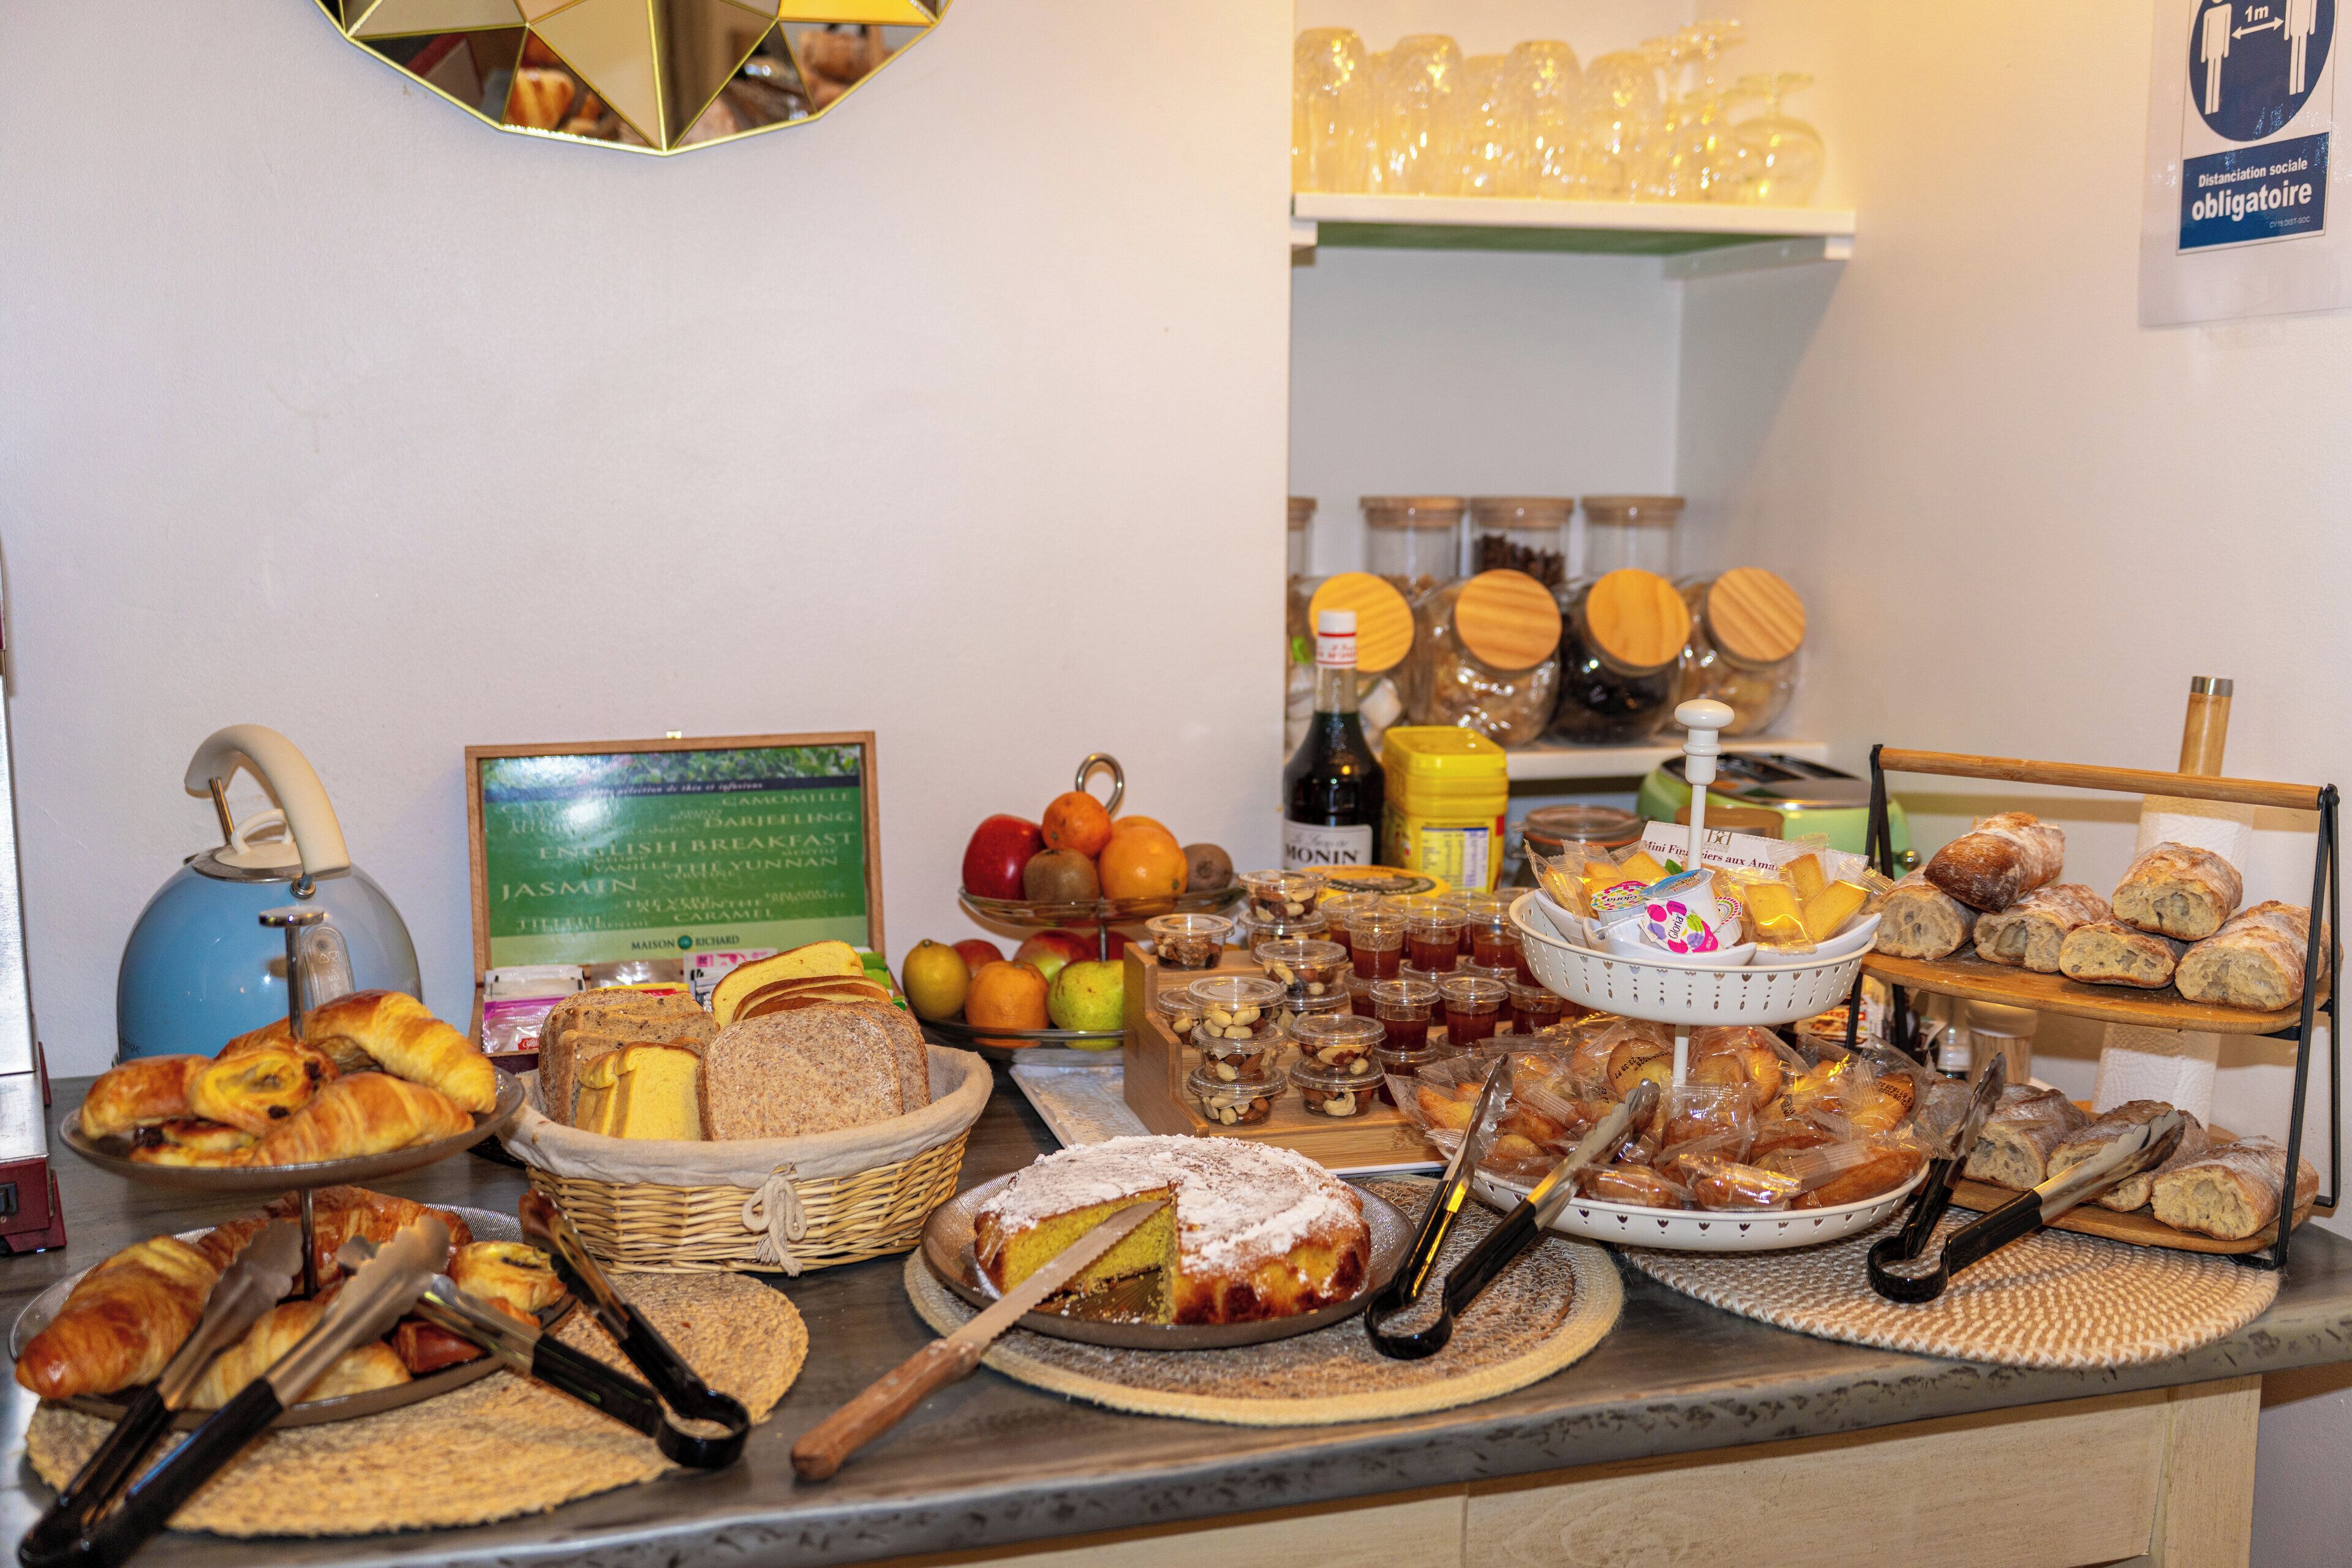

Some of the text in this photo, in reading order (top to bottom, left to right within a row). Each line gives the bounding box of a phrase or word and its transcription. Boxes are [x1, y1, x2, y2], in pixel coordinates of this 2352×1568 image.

[2245, 5, 2269, 23] 1m
[2198, 157, 2308, 188] Distanciation sociale
[2192, 179, 2312, 222] obligatoire
[721, 792, 851, 807] CAMOMILLE
[704, 811, 854, 828] DARJEELING
[539, 832, 855, 860] ENGLISH BREAKFAST
[730, 856, 839, 870] YUNNAN
[1725, 856, 1746, 865] aux
[501, 877, 638, 902] JASMIN
[1668, 916, 1684, 940] Gloria
[631, 940, 674, 950] MAISON
[695, 935, 740, 946] RICHARD
[1615, 1069, 1622, 1079] F7
